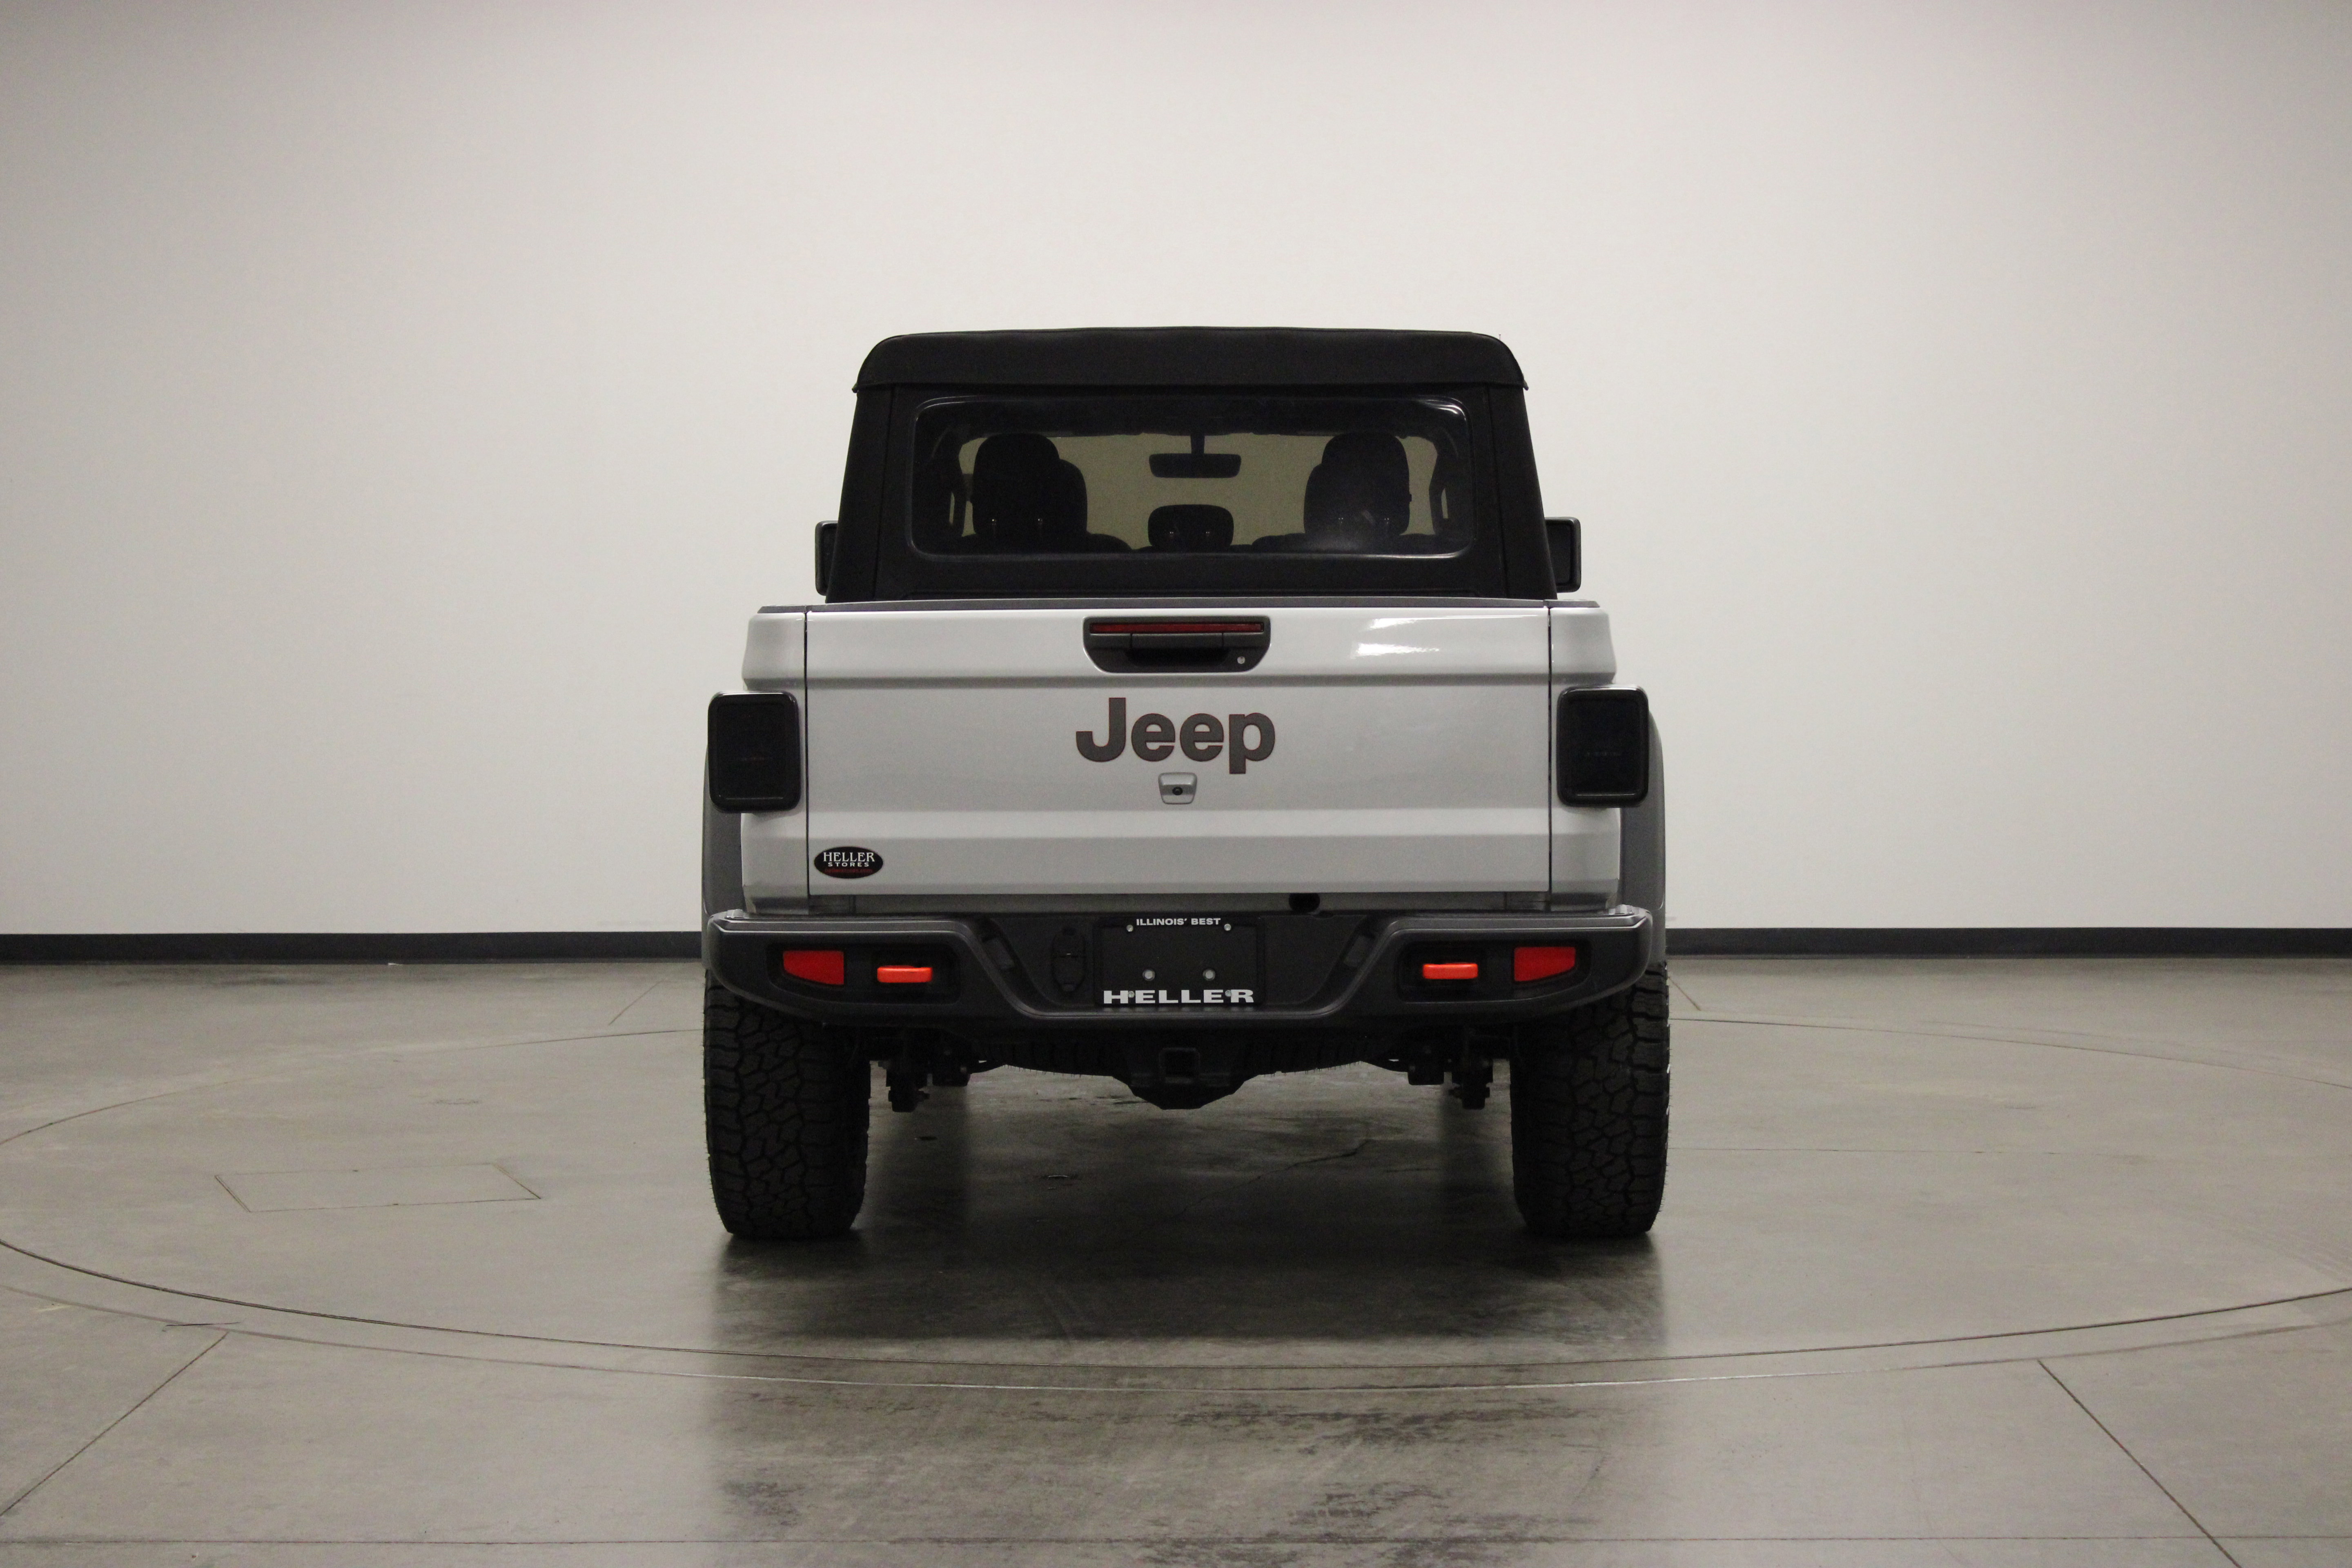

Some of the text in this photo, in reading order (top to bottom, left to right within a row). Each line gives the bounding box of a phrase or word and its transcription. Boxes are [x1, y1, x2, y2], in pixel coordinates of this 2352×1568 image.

[1076, 697, 1275, 774] Jeep
[823, 852, 875, 862] HELLER
[1104, 989, 1254, 1004] HELLER
